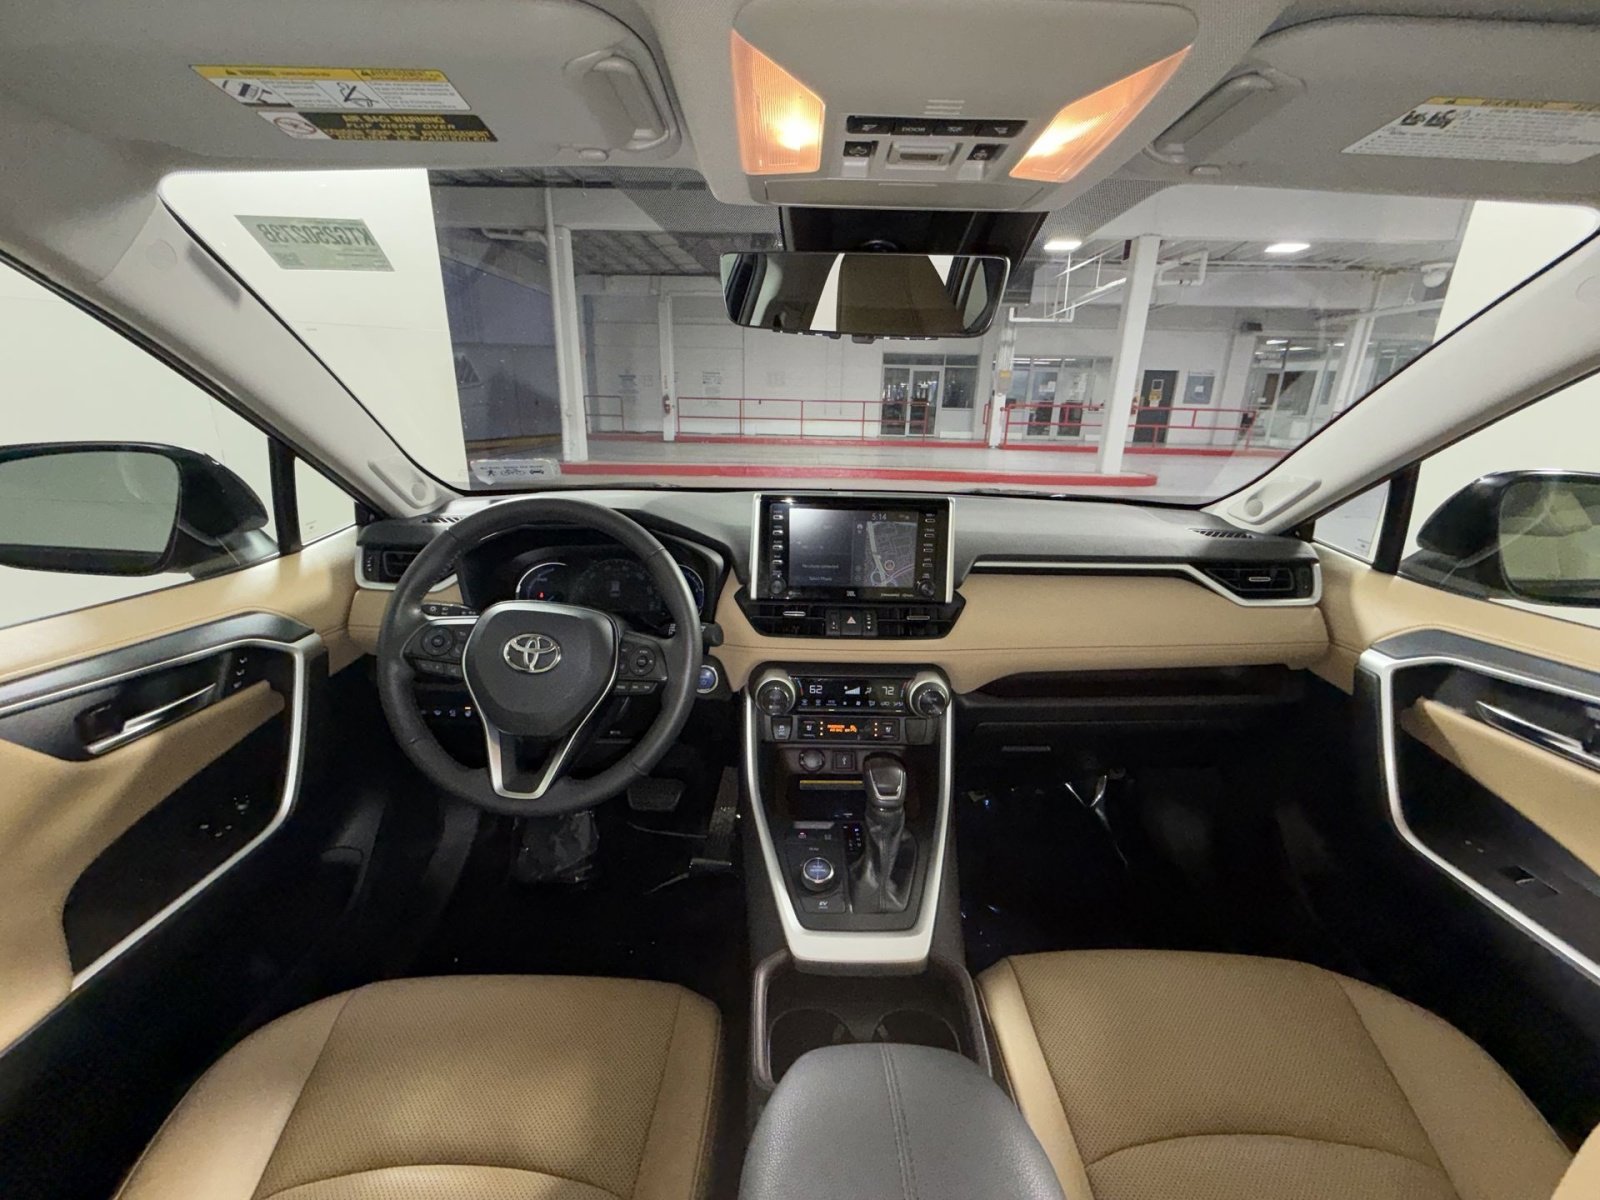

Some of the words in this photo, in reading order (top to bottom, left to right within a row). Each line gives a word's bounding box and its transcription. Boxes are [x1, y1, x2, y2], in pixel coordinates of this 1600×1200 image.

[364, 115, 390, 123] BAG
[390, 115, 445, 124] WARNING
[871, 512, 887, 521] 5:14
[809, 684, 823, 695] 62
[881, 686, 895, 696] 72
